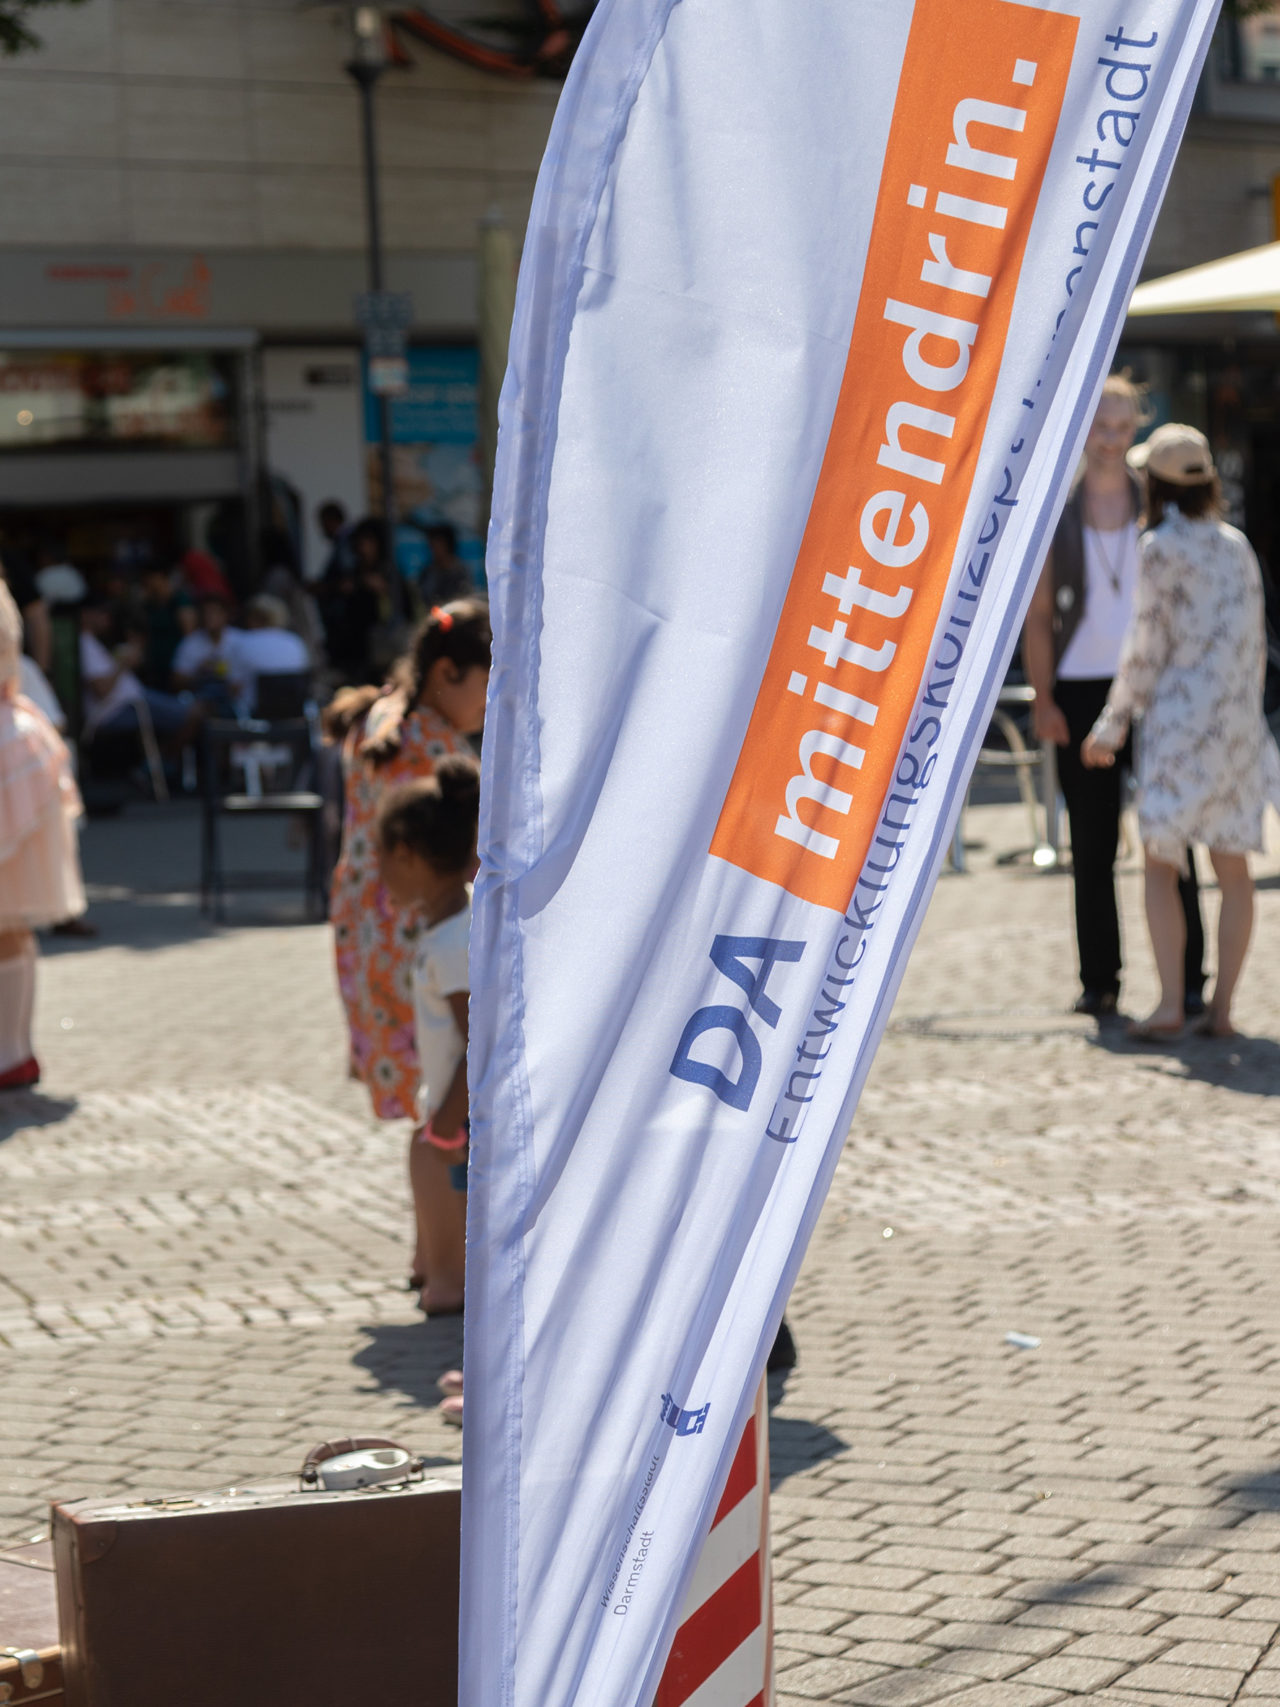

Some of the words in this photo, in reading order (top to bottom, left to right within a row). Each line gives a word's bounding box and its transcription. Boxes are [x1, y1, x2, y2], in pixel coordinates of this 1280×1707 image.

[669, 934, 808, 1112] DA
[774, 58, 1038, 860] mittendrin.
[614, 1530, 655, 1616] Darmstadt
